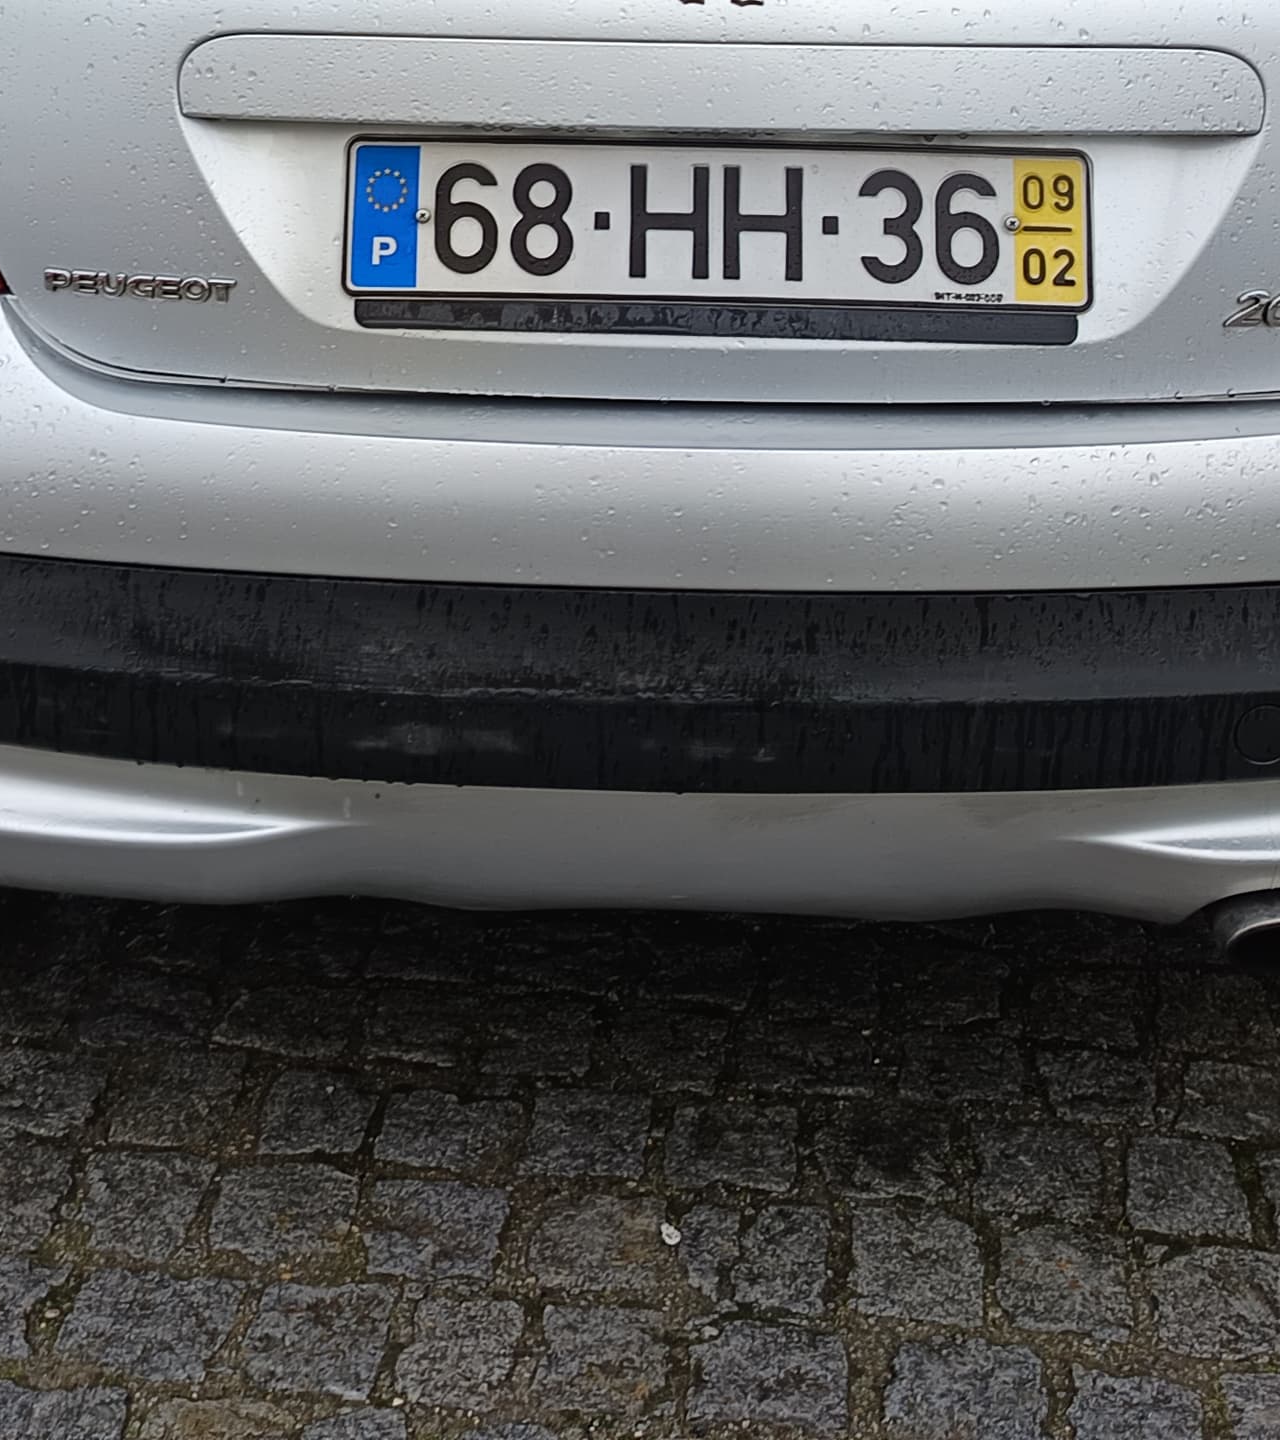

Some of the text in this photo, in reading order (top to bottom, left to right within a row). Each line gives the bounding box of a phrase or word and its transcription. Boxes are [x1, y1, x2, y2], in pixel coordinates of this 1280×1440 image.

[1022, 174, 1074, 211] 09
[371, 236, 397, 265] P
[1022, 248, 1076, 286] 02
[43, 267, 238, 304] PEUGEOT
